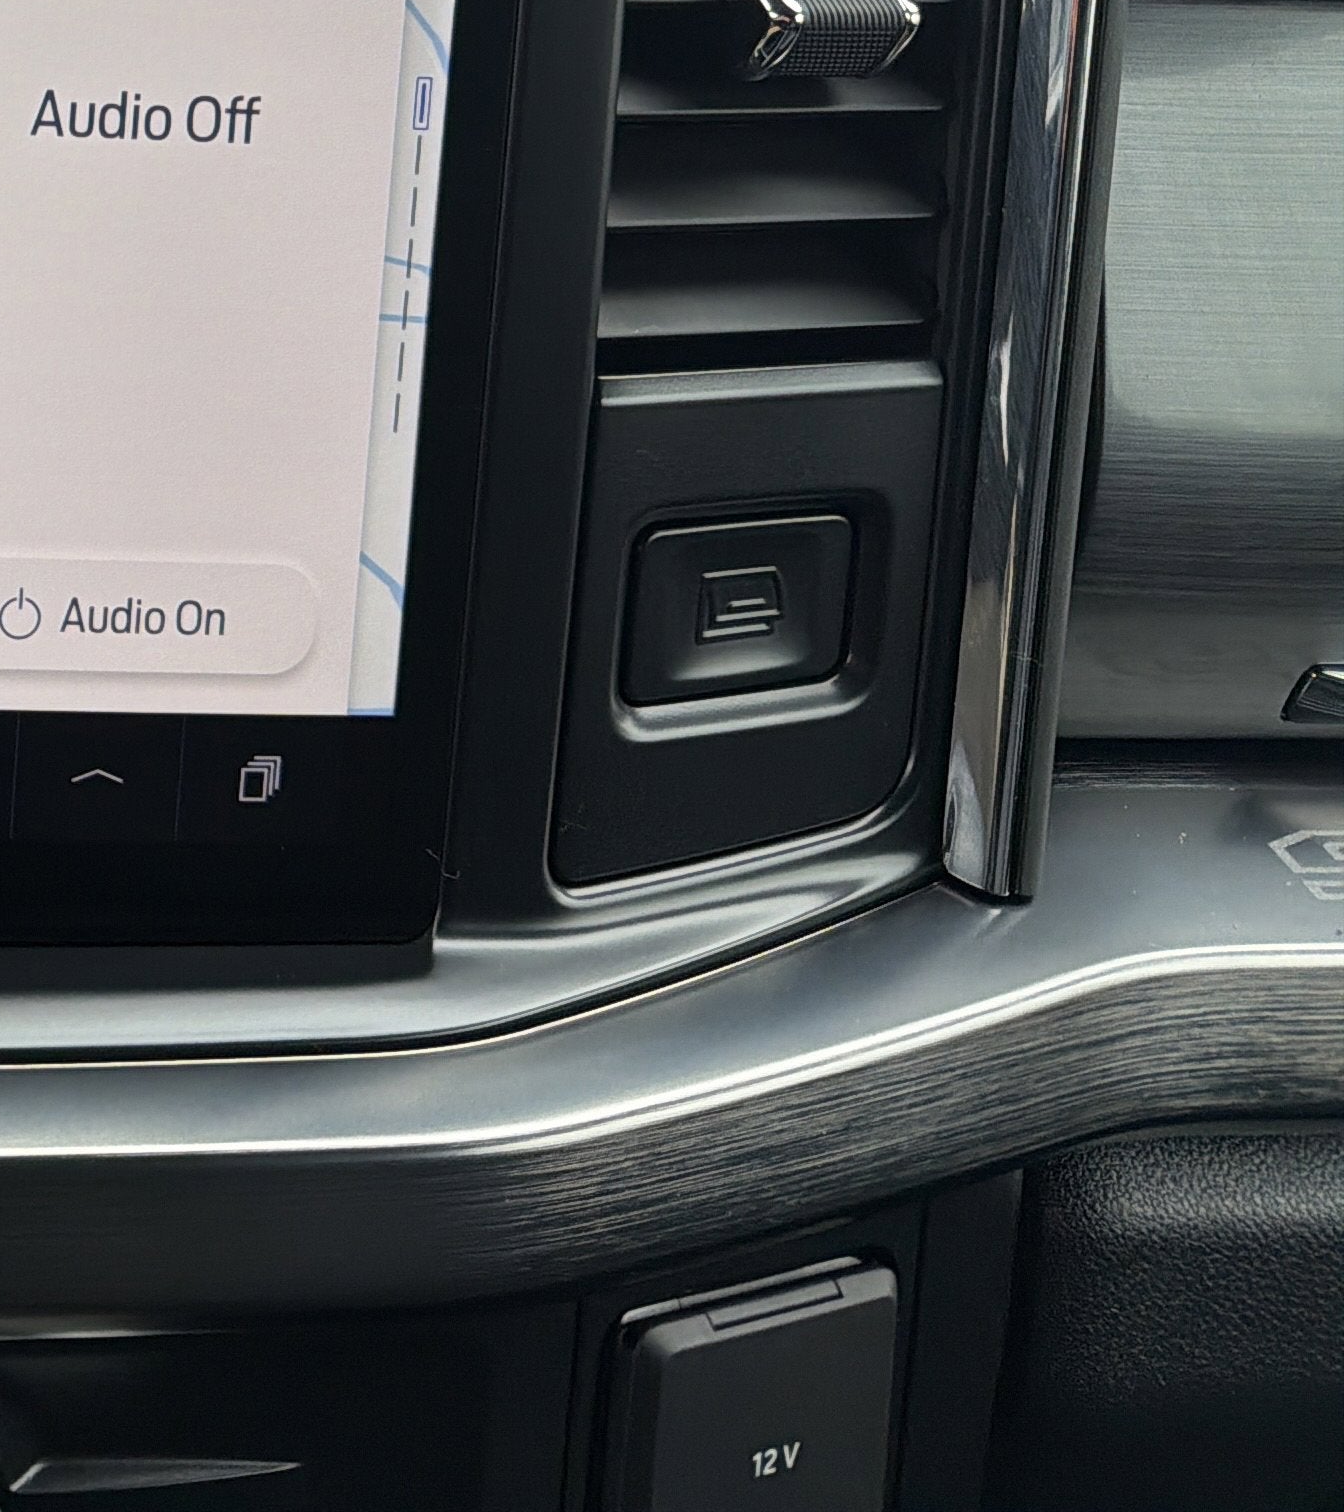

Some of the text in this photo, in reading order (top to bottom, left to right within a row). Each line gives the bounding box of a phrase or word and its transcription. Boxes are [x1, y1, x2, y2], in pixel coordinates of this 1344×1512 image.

[30, 89, 262, 144] Audio Off
[59, 597, 226, 637] Audio On
